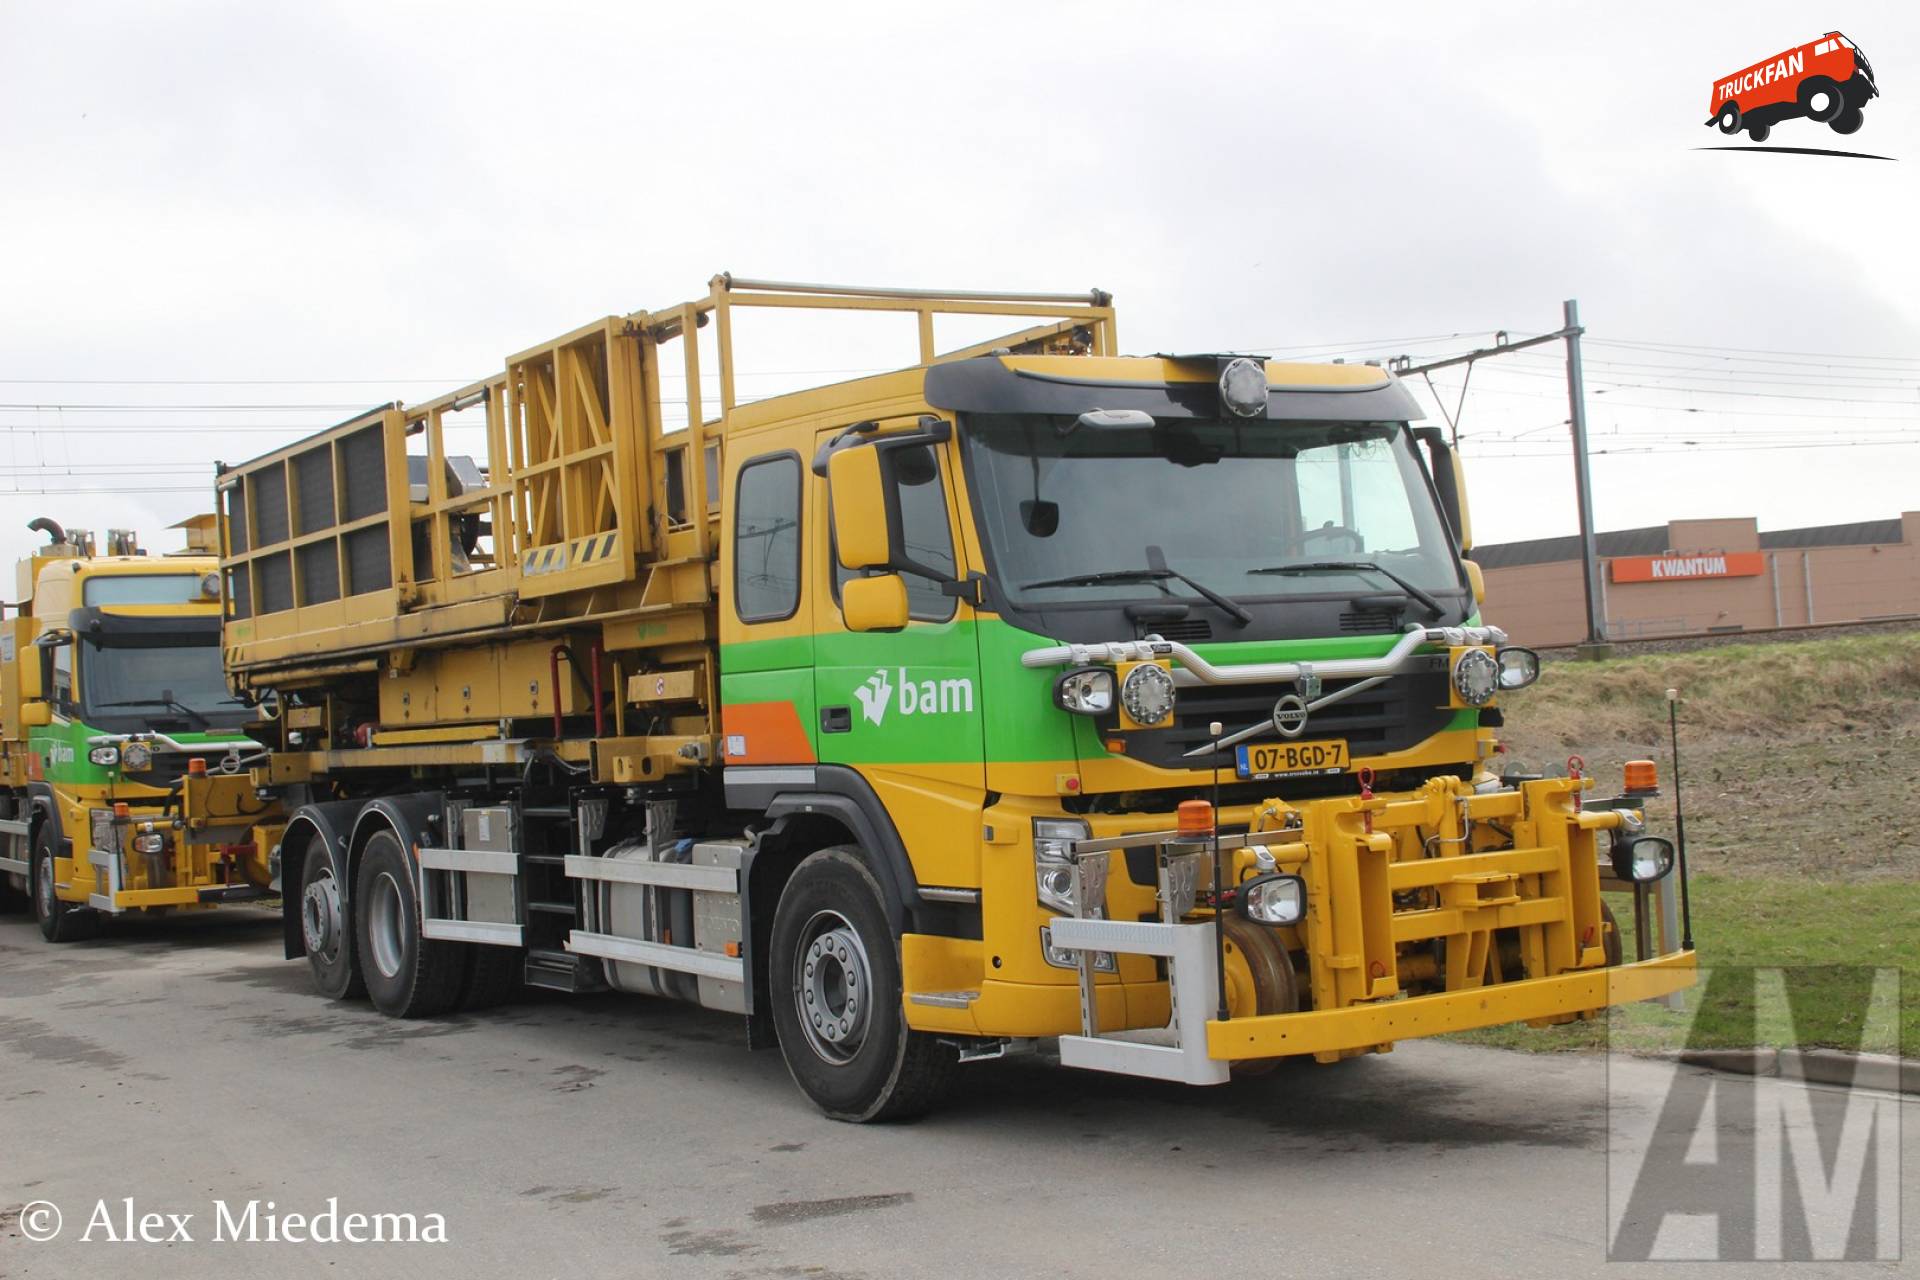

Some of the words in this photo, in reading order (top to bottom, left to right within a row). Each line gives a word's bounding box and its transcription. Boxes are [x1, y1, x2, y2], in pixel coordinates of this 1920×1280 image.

[1652, 557, 1727, 577] KWANTUM
[899, 667, 973, 715] bam
[1276, 711, 1306, 720] VOLVO
[1255, 745, 1341, 771] 07-BGD-7
